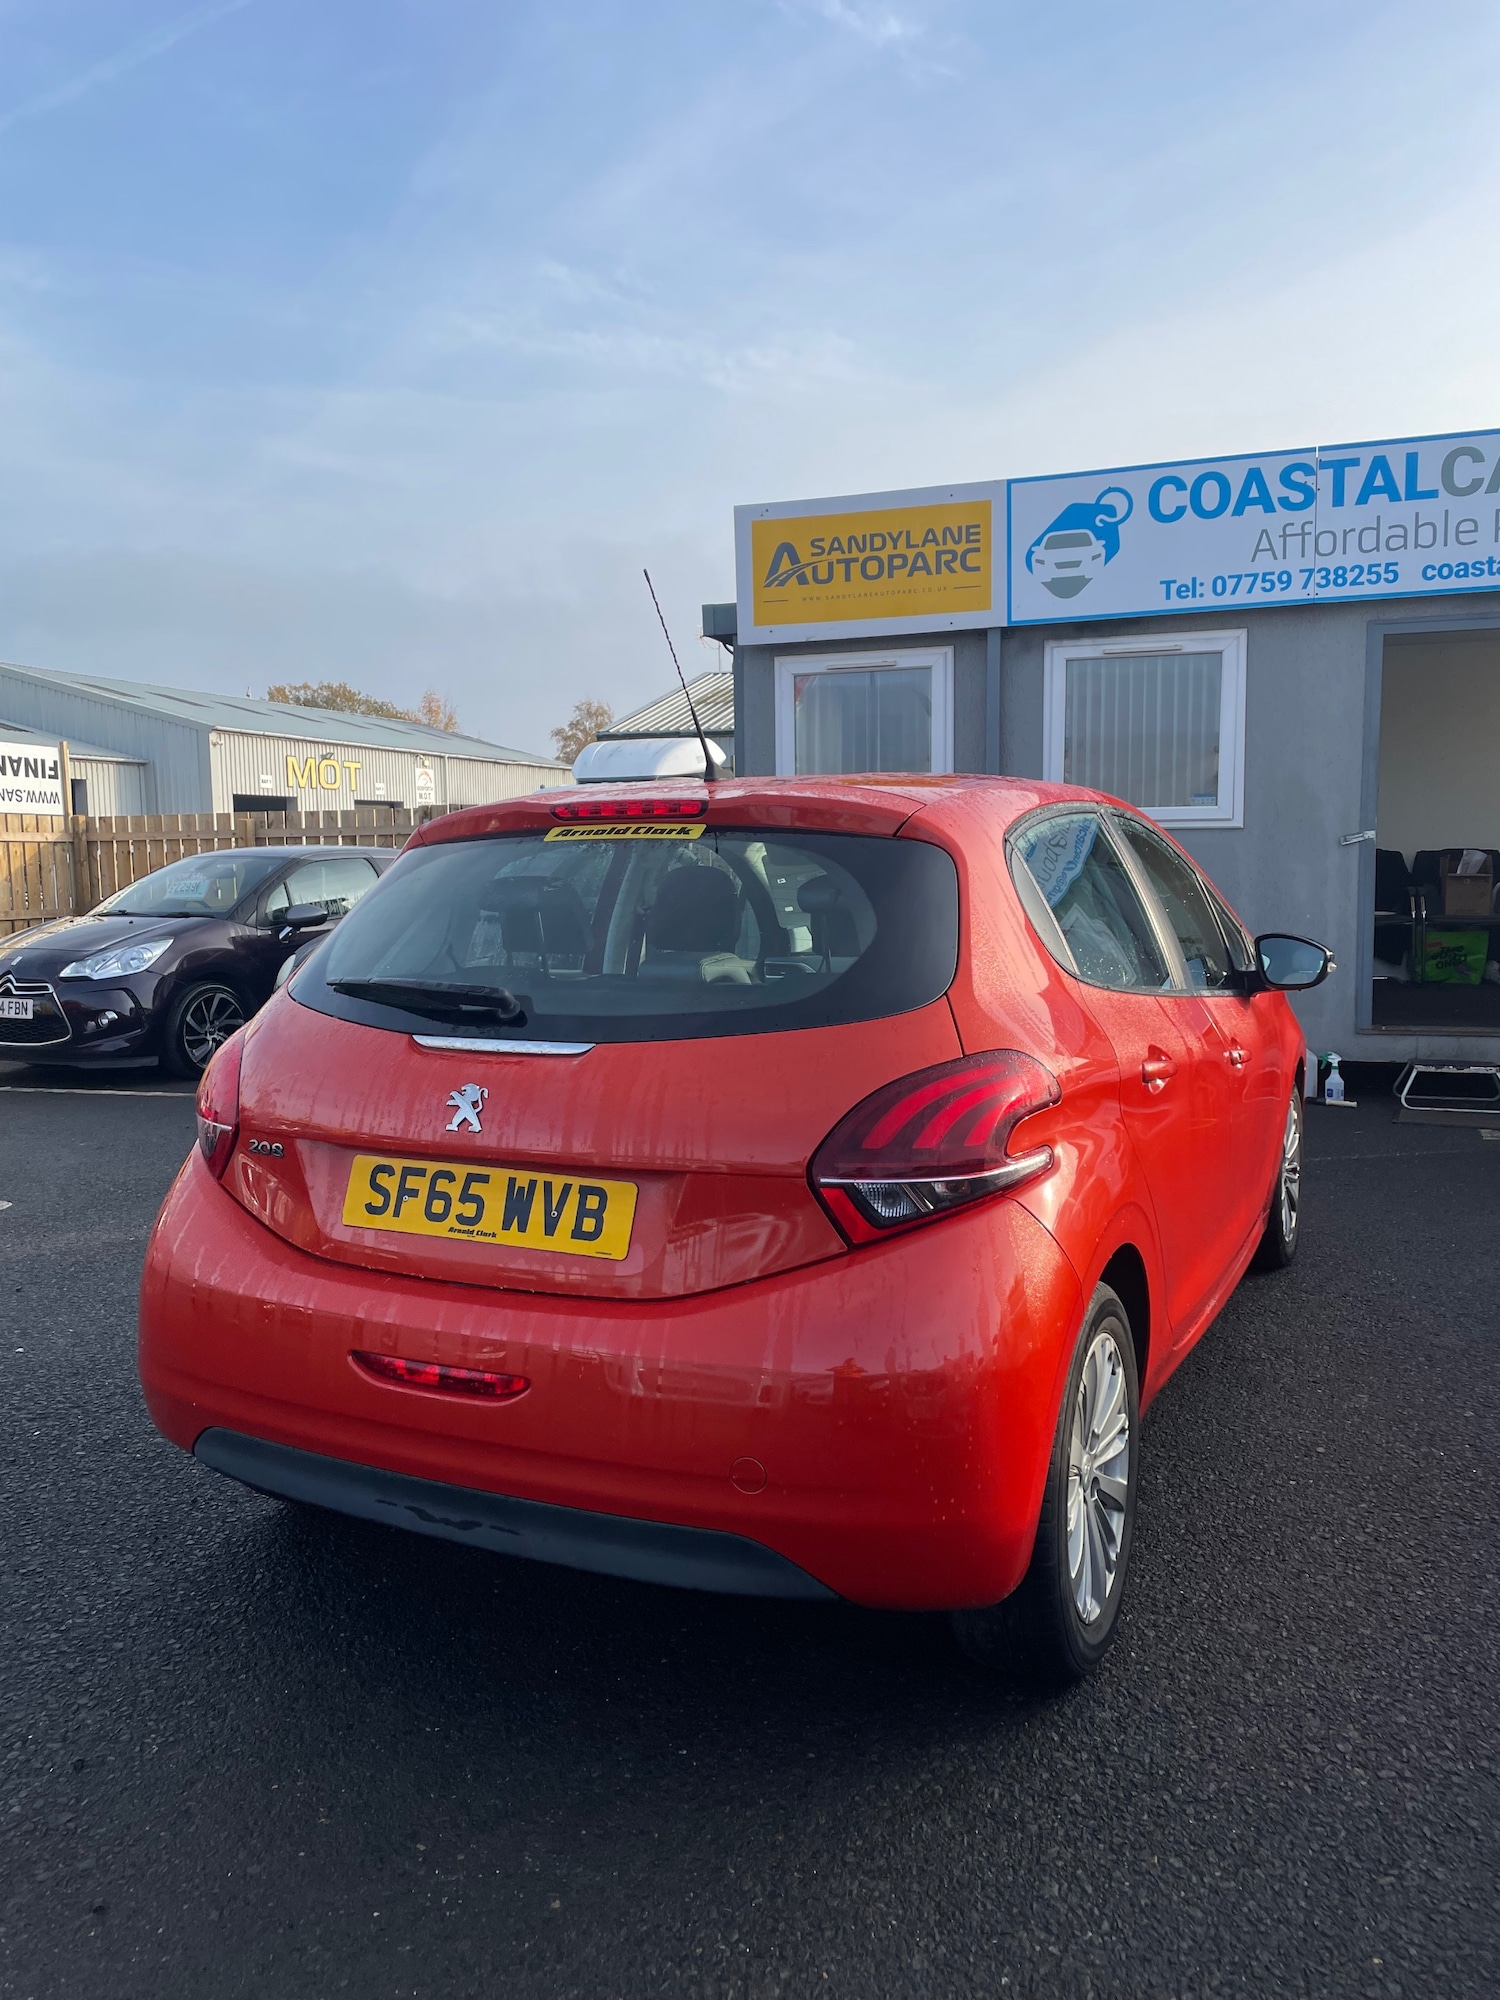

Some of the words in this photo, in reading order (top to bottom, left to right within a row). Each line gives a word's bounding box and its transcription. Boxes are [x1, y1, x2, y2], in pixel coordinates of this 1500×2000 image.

[810, 524, 981, 557] SANDYLANE
[1250, 508, 1479, 562] Affordable
[763, 547, 981, 588] AUTOPARC
[1160, 577, 1205, 600] Tel:
[1211, 570, 1292, 597] 07759
[1299, 562, 1399, 590] 738255
[1421, 556, 1500, 581] coast
[286, 756, 361, 791] MOT
[554, 827, 632, 837] Arnold
[631, 826, 694, 836] Clark
[7, 1001, 28, 1016] FBN
[249, 1138, 284, 1158] 208
[364, 1163, 490, 1227] SF65
[501, 1176, 609, 1242] WVB
